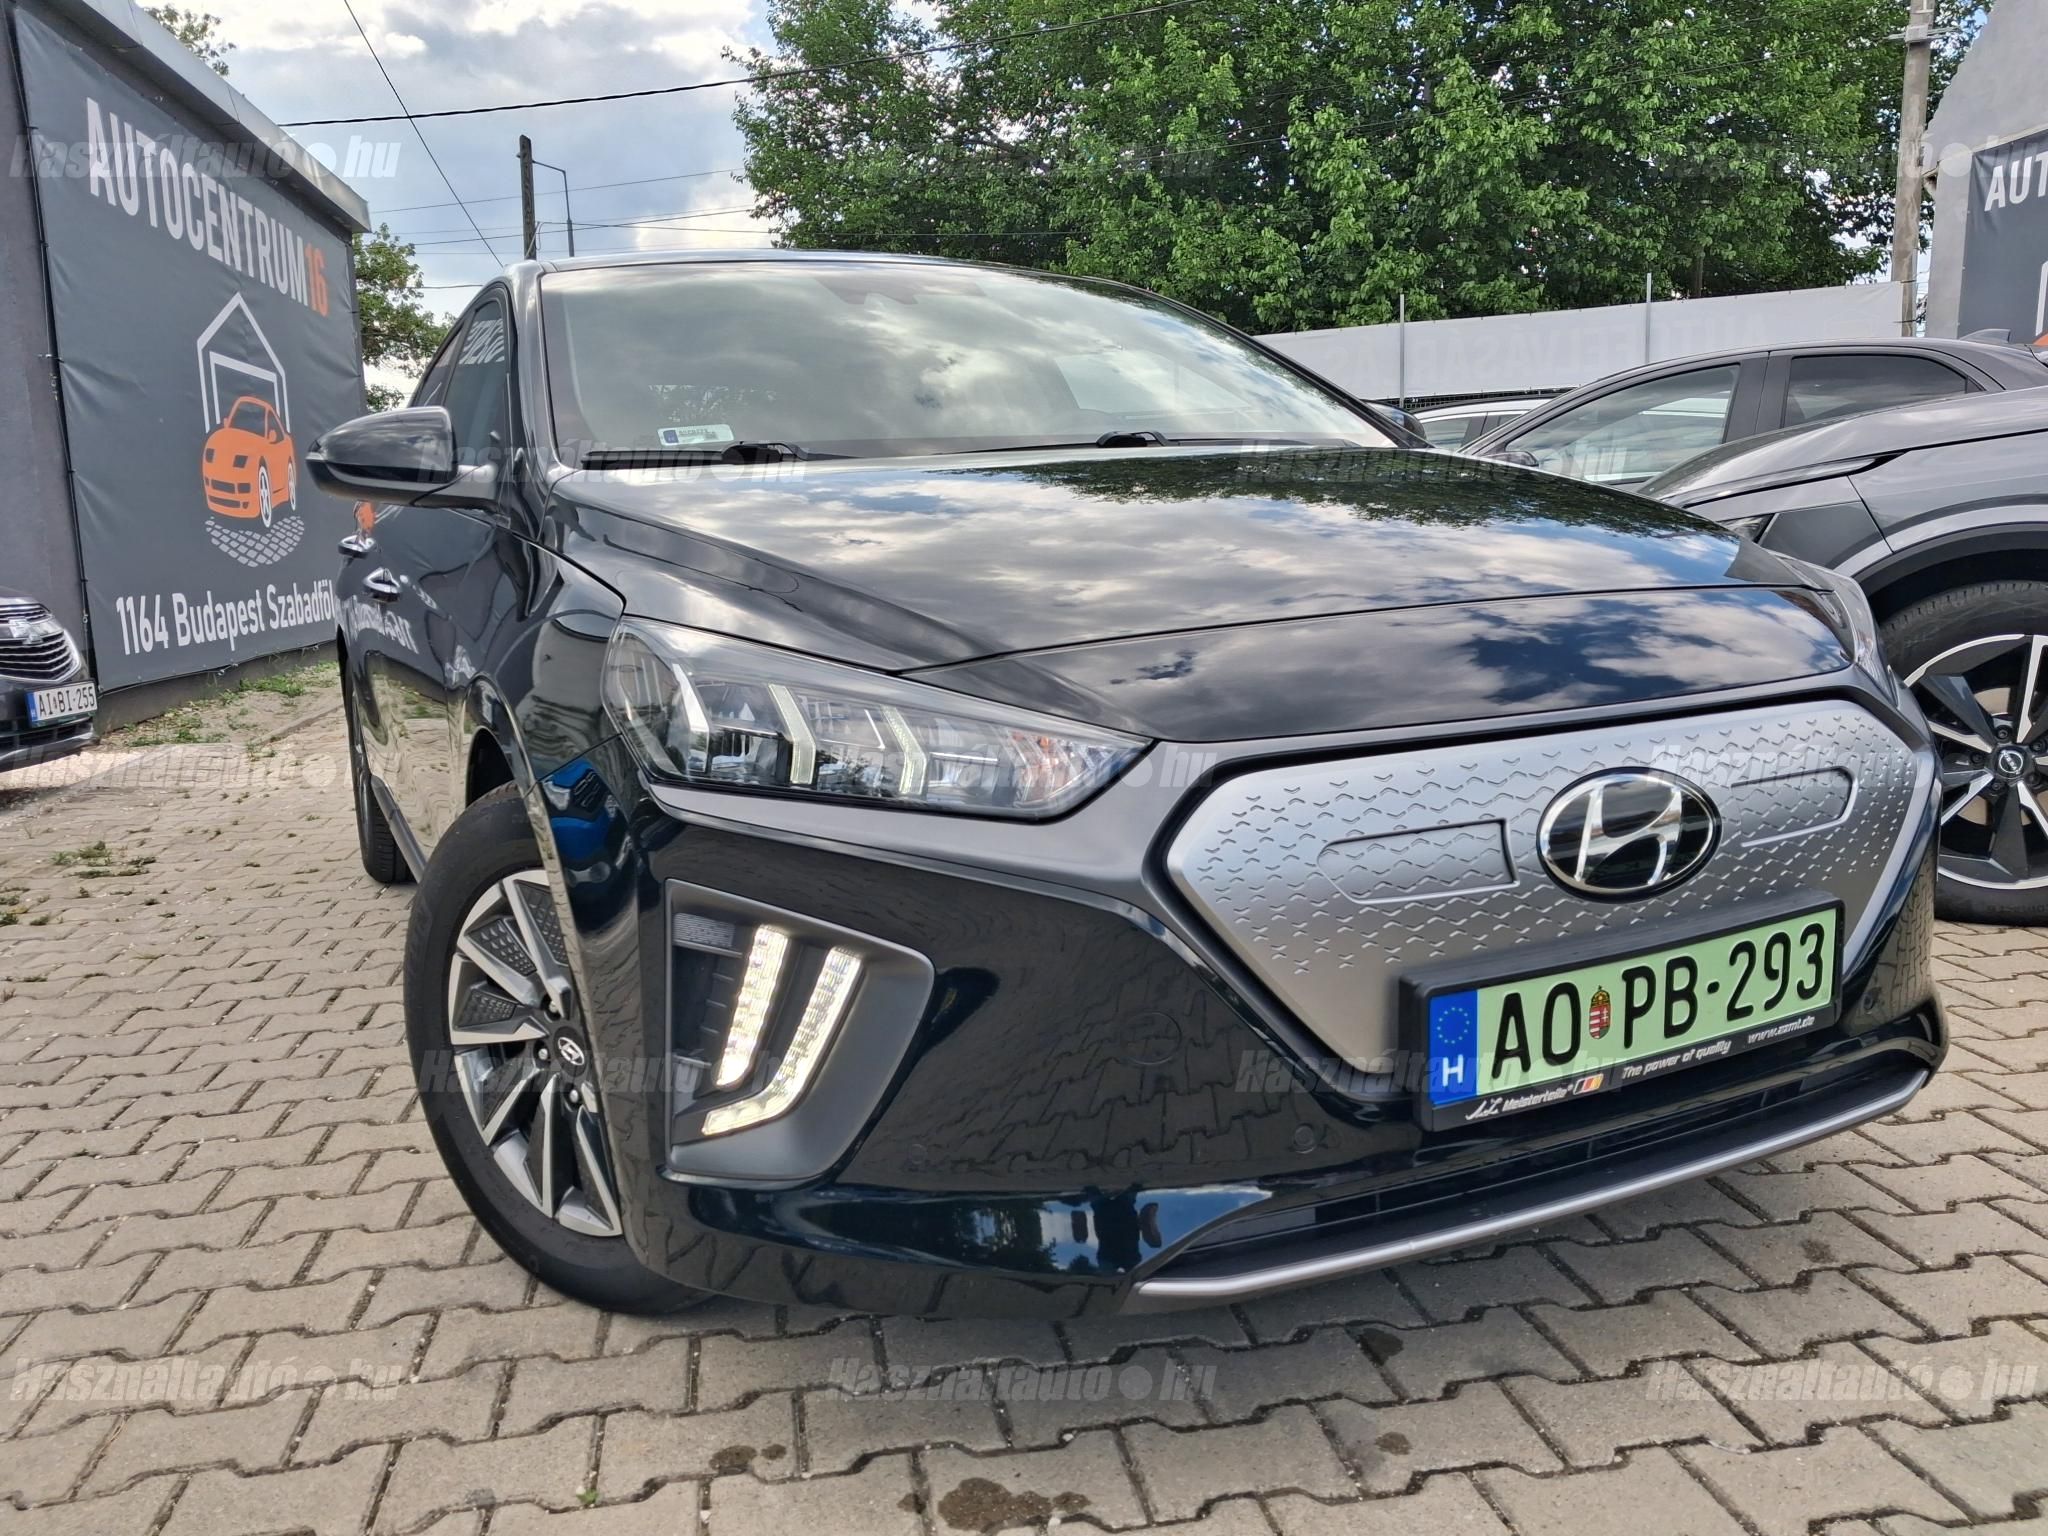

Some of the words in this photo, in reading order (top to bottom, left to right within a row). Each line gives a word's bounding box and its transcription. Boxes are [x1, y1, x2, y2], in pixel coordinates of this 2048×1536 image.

[116, 593, 170, 656] 1164
[172, 588, 266, 651] Budapest
[267, 579, 336, 630] Szabadföl
[39, 692, 54, 717] AI
[1441, 1054, 1464, 1087] H
[1491, 981, 1582, 1079] AO
[1621, 1066, 1643, 1080] The
[1644, 1055, 1680, 1076] power
[1682, 1049, 1695, 1063] of
[1696, 1039, 1733, 1060] quality
